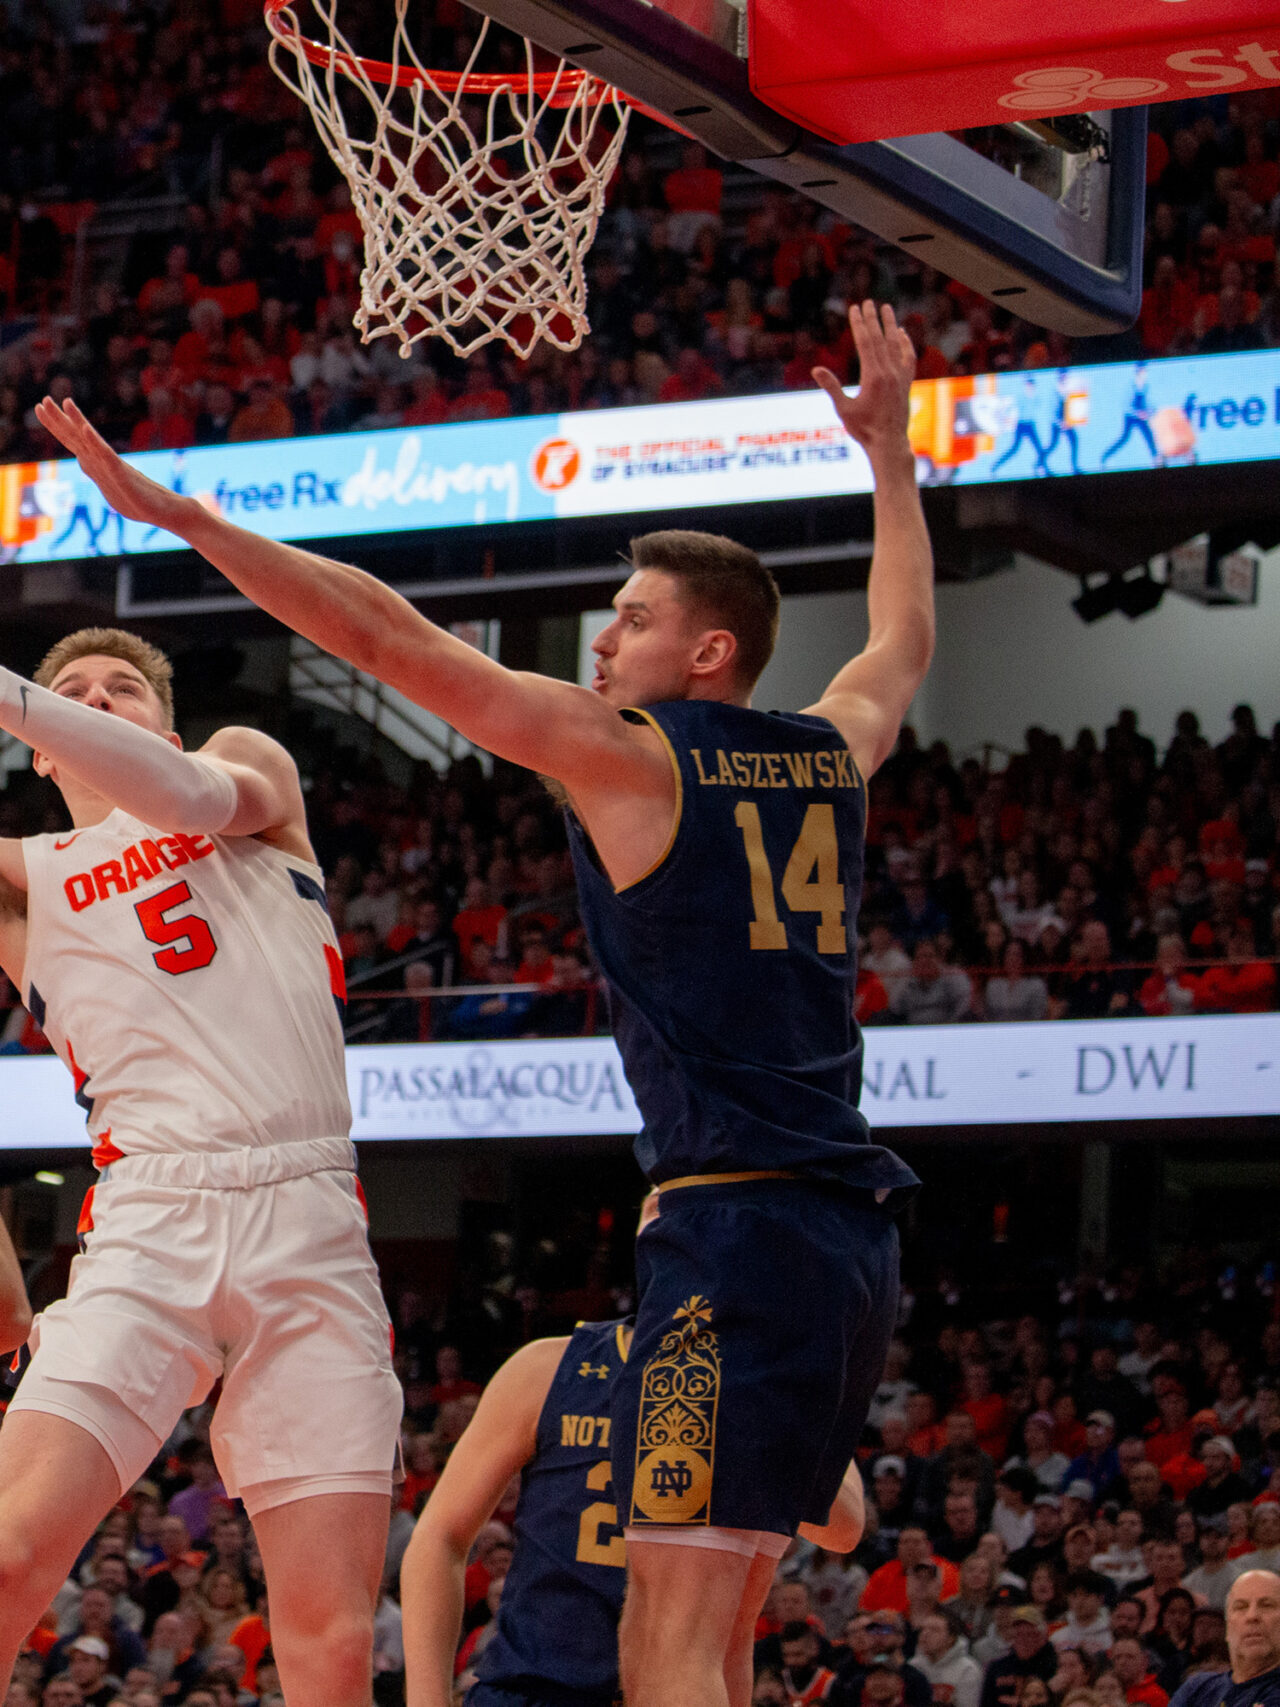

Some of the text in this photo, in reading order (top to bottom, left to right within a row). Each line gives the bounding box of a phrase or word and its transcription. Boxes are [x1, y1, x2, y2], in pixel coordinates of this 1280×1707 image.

[1184, 393, 1266, 430] free
[214, 471, 342, 514] free Rx
[63, 833, 216, 913] ORANGE
[734, 801, 847, 954] 14
[133, 880, 218, 976] 5
[358, 1060, 626, 1119] PASSALACQUA
[1075, 1041, 1198, 1095] DWI
